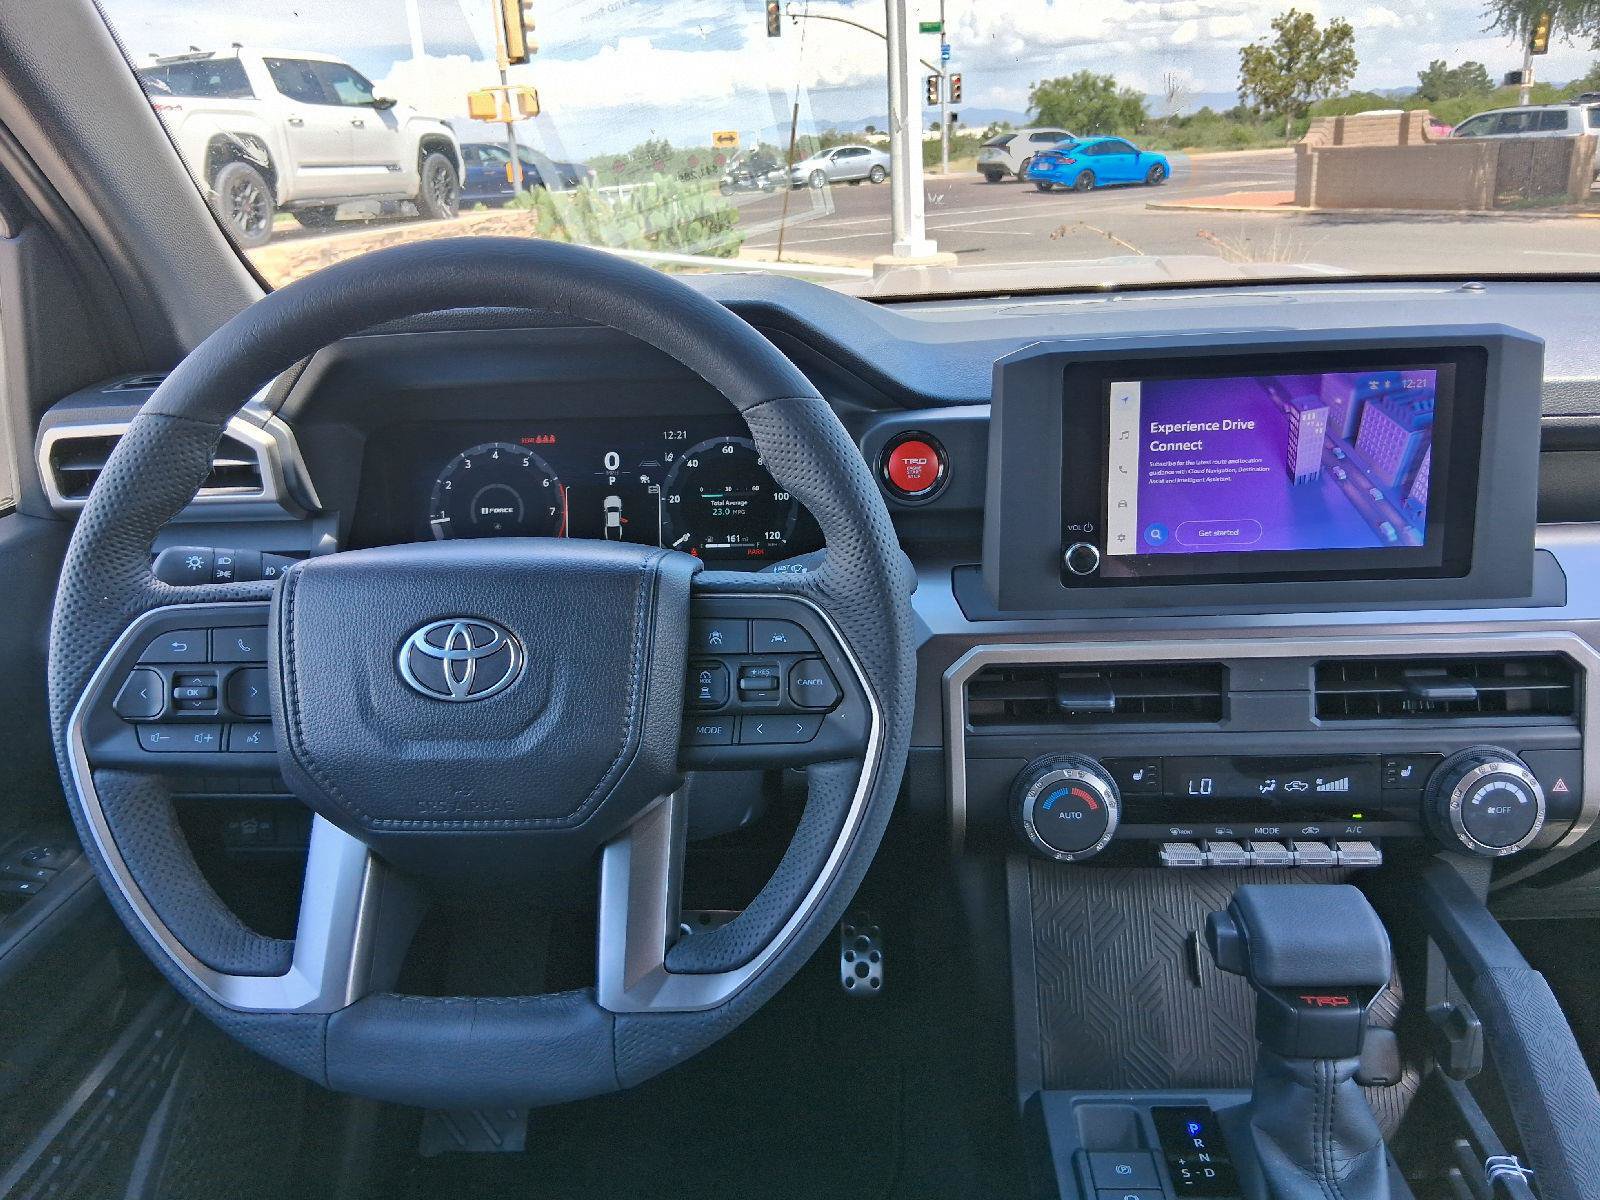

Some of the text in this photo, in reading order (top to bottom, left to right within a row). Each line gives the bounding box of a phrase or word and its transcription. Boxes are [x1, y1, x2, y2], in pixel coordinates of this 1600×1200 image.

[1402, 379, 1427, 389] 12:21
[1150, 419, 1255, 435] Experience Drive
[663, 430, 688, 440] 12:21
[722, 445, 734, 454] 60
[1149, 440, 1203, 452] Connect
[492, 450, 499, 460] 4
[465, 459, 472, 469] 3
[522, 458, 529, 467] 5
[604, 451, 620, 471] 0
[687, 459, 699, 468] 40
[445, 480, 452, 490] 2
[542, 478, 549, 488] 6
[608, 476, 616, 486] P
[669, 494, 681, 504] 20
[773, 492, 790, 501] 100
[440, 510, 446, 519] 1
[549, 507, 556, 516] 7
[712, 508, 731, 516] 23.0
[764, 531, 780, 540] 120
[1213, 528, 1240, 537] started
[726, 534, 740, 543] 161
[797, 678, 824, 686] CANCEL
[186, 689, 199, 697] OK
[696, 726, 723, 734] MODE
[1495, 806, 1511, 814] OFF
[1058, 811, 1082, 819] AUTO
[1254, 827, 1280, 835] MODE
[1345, 826, 1362, 834] A/C
[1299, 996, 1350, 1007] TRD
[1189, 1123, 1199, 1134] P
[1193, 1138, 1205, 1148] R
[1198, 1153, 1210, 1162] N
[1181, 1168, 1191, 1178] S
[1204, 1168, 1216, 1178] D
